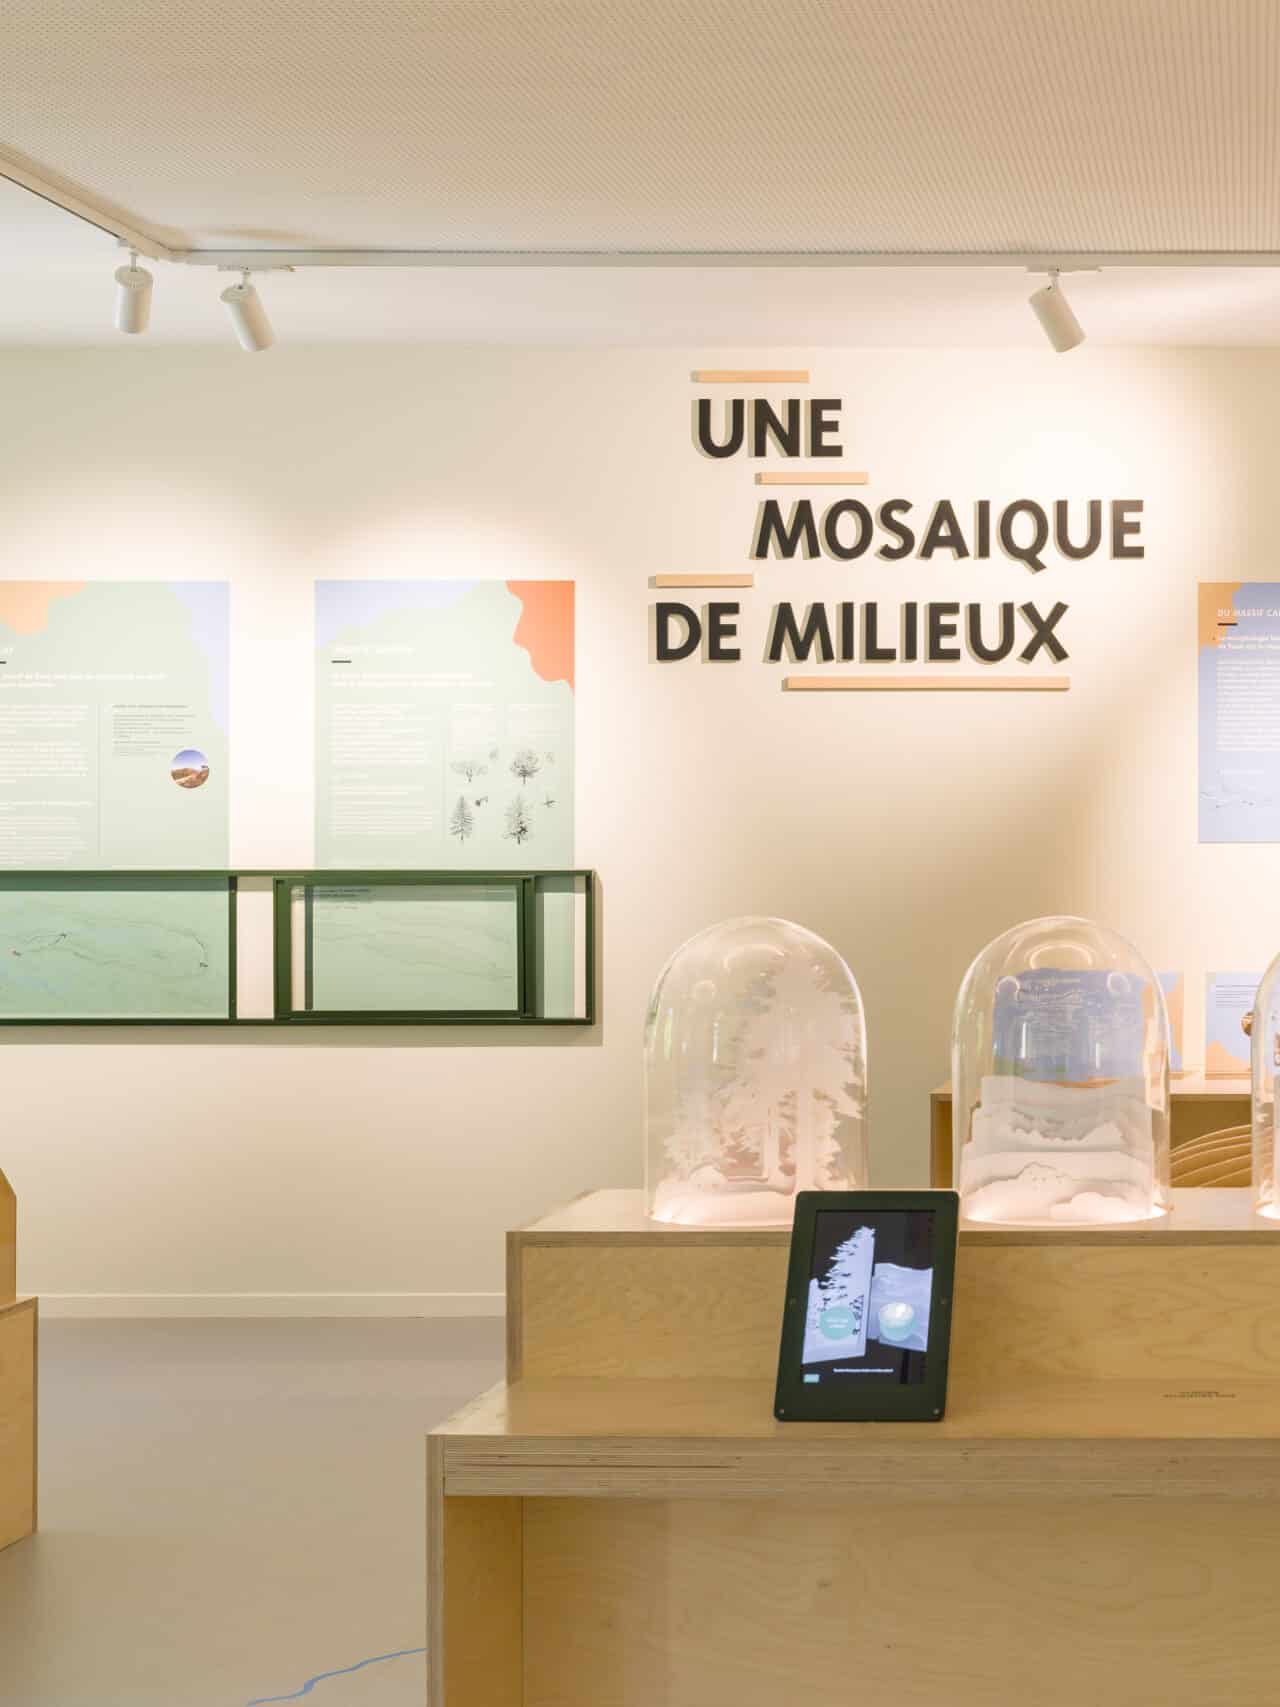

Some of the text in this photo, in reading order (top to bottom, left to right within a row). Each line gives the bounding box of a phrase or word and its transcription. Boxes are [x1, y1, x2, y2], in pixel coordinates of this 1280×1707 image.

[697, 398, 843, 458] UNE
[755, 499, 1144, 574] MOSAIQUE
[655, 602, 1070, 663] DE MILIEUX
